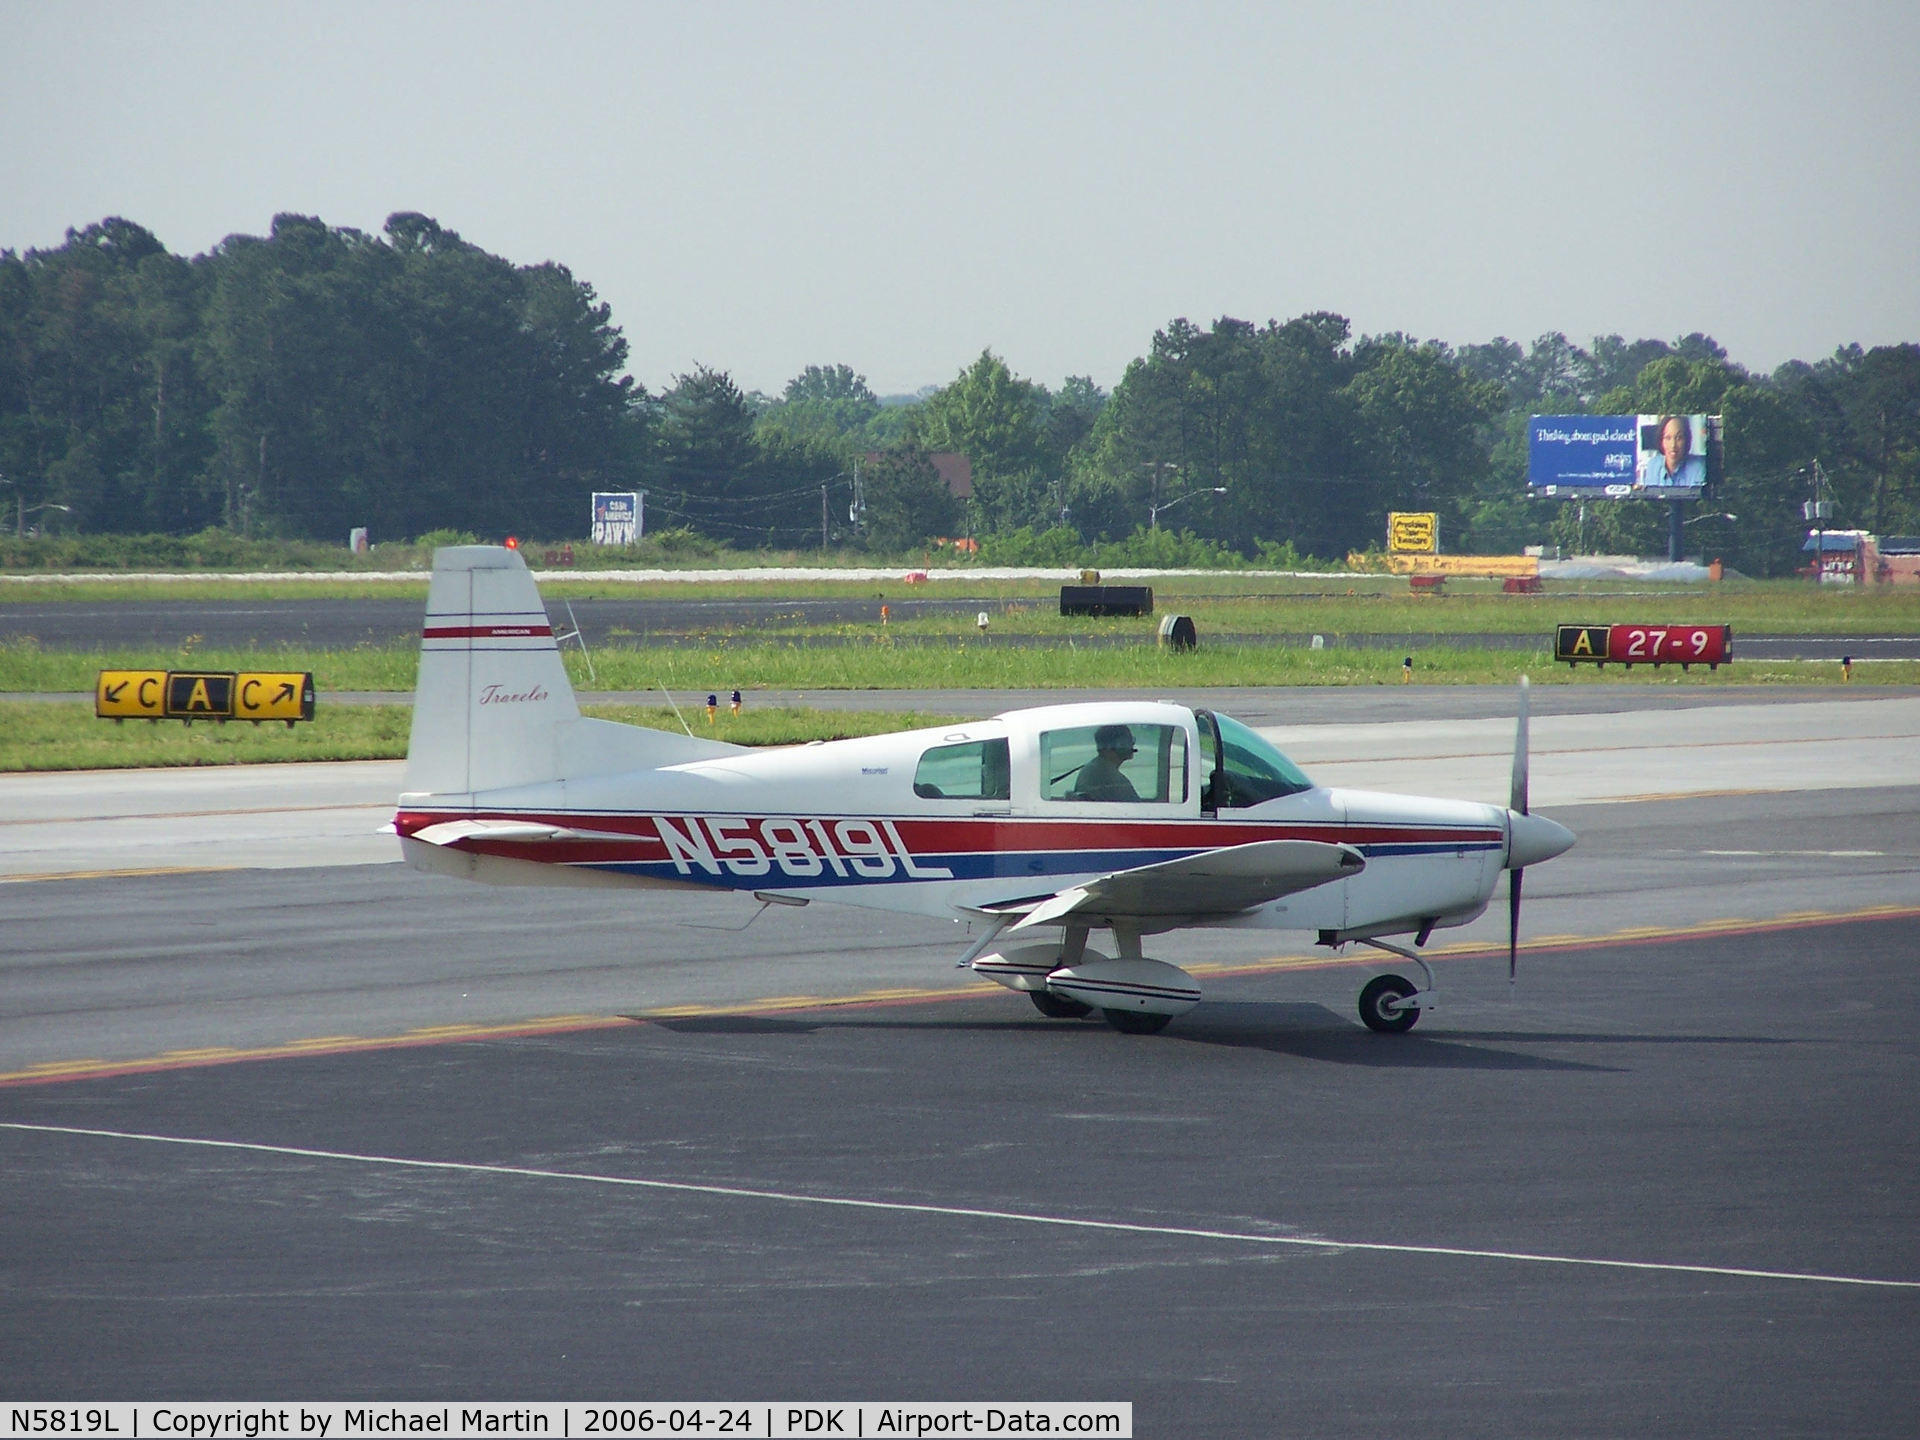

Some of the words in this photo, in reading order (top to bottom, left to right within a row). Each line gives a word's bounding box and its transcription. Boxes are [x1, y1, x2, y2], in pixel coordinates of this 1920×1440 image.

[595, 522, 634, 546] PAWN
[1572, 629, 1593, 655] A
[1628, 630, 1708, 656] 27-9
[138, 678, 158, 708] C
[186, 679, 212, 710] A
[242, 680, 261, 710] C
[480, 684, 549, 705] Traveler
[652, 817, 954, 878] N5819L
